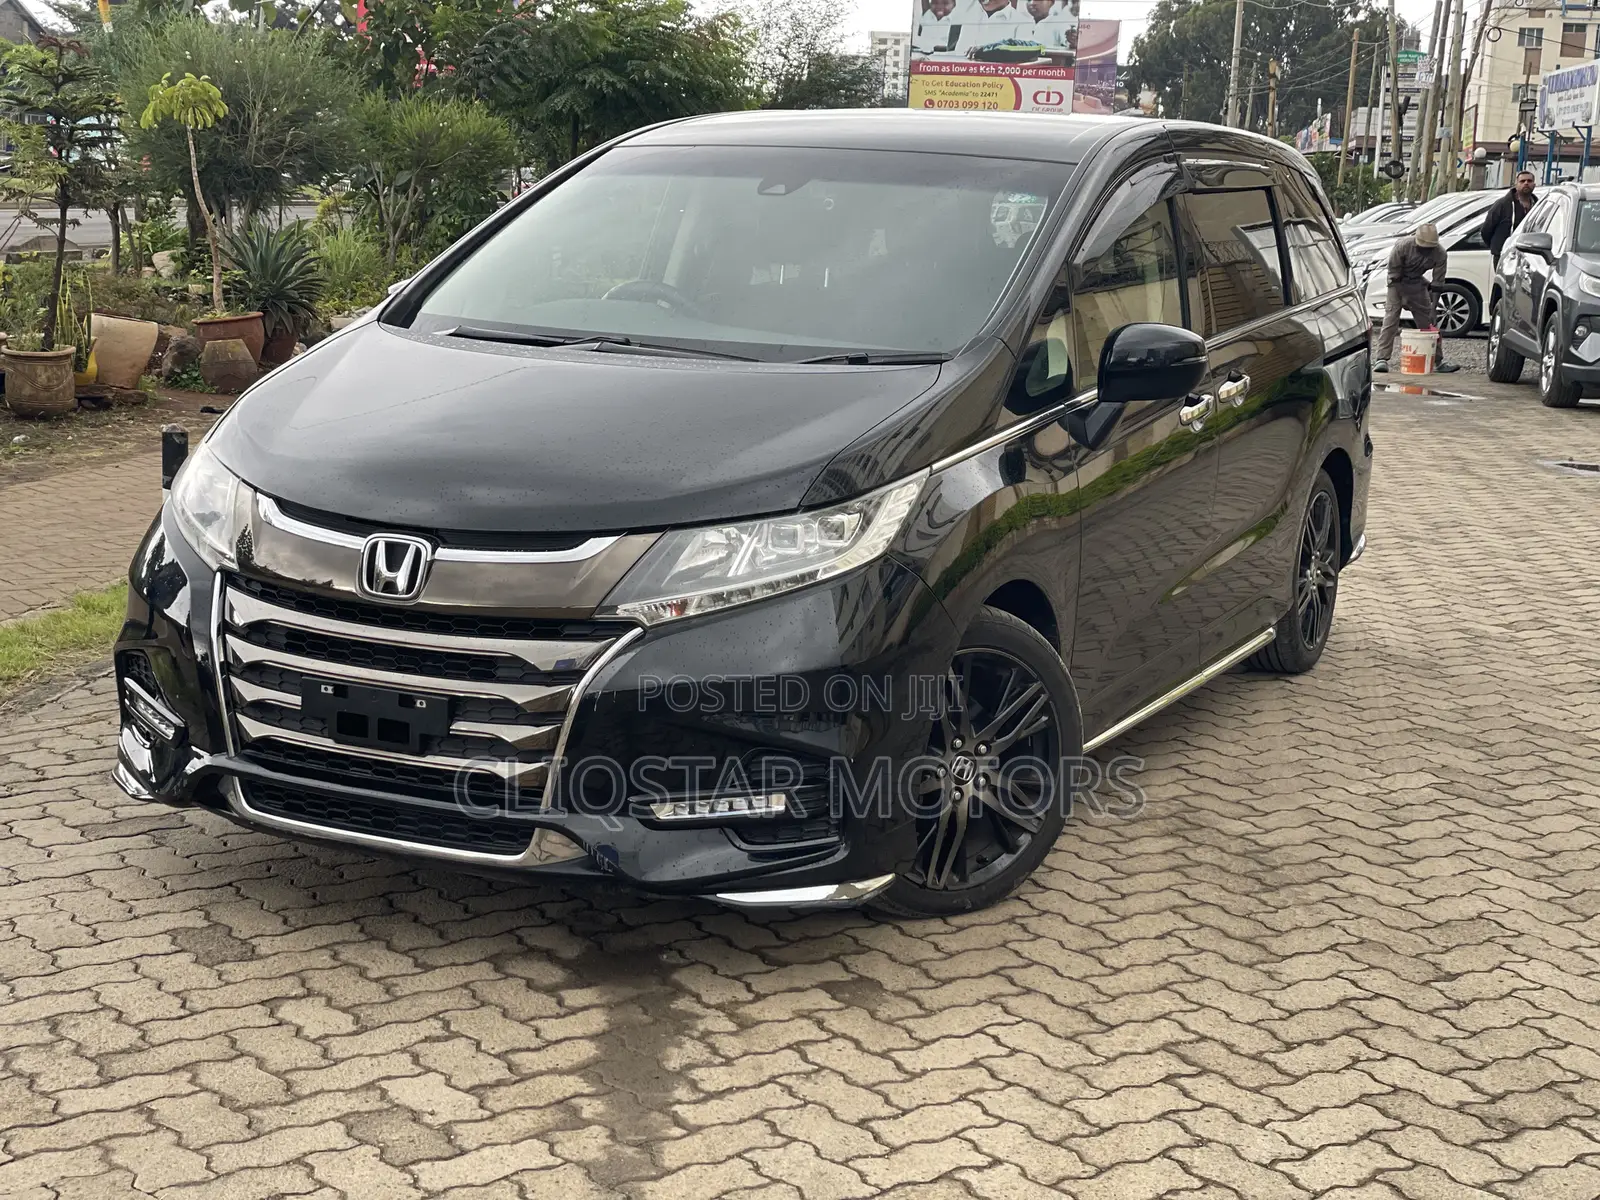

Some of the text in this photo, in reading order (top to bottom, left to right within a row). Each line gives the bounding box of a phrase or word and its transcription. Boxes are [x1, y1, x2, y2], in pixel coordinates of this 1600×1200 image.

[919, 62, 1066, 77] from as low as Ksh 2,000 per month
[945, 80, 981, 88] Education
[982, 81, 1004, 90] Policy
[937, 100, 999, 110] 0703 099 120
